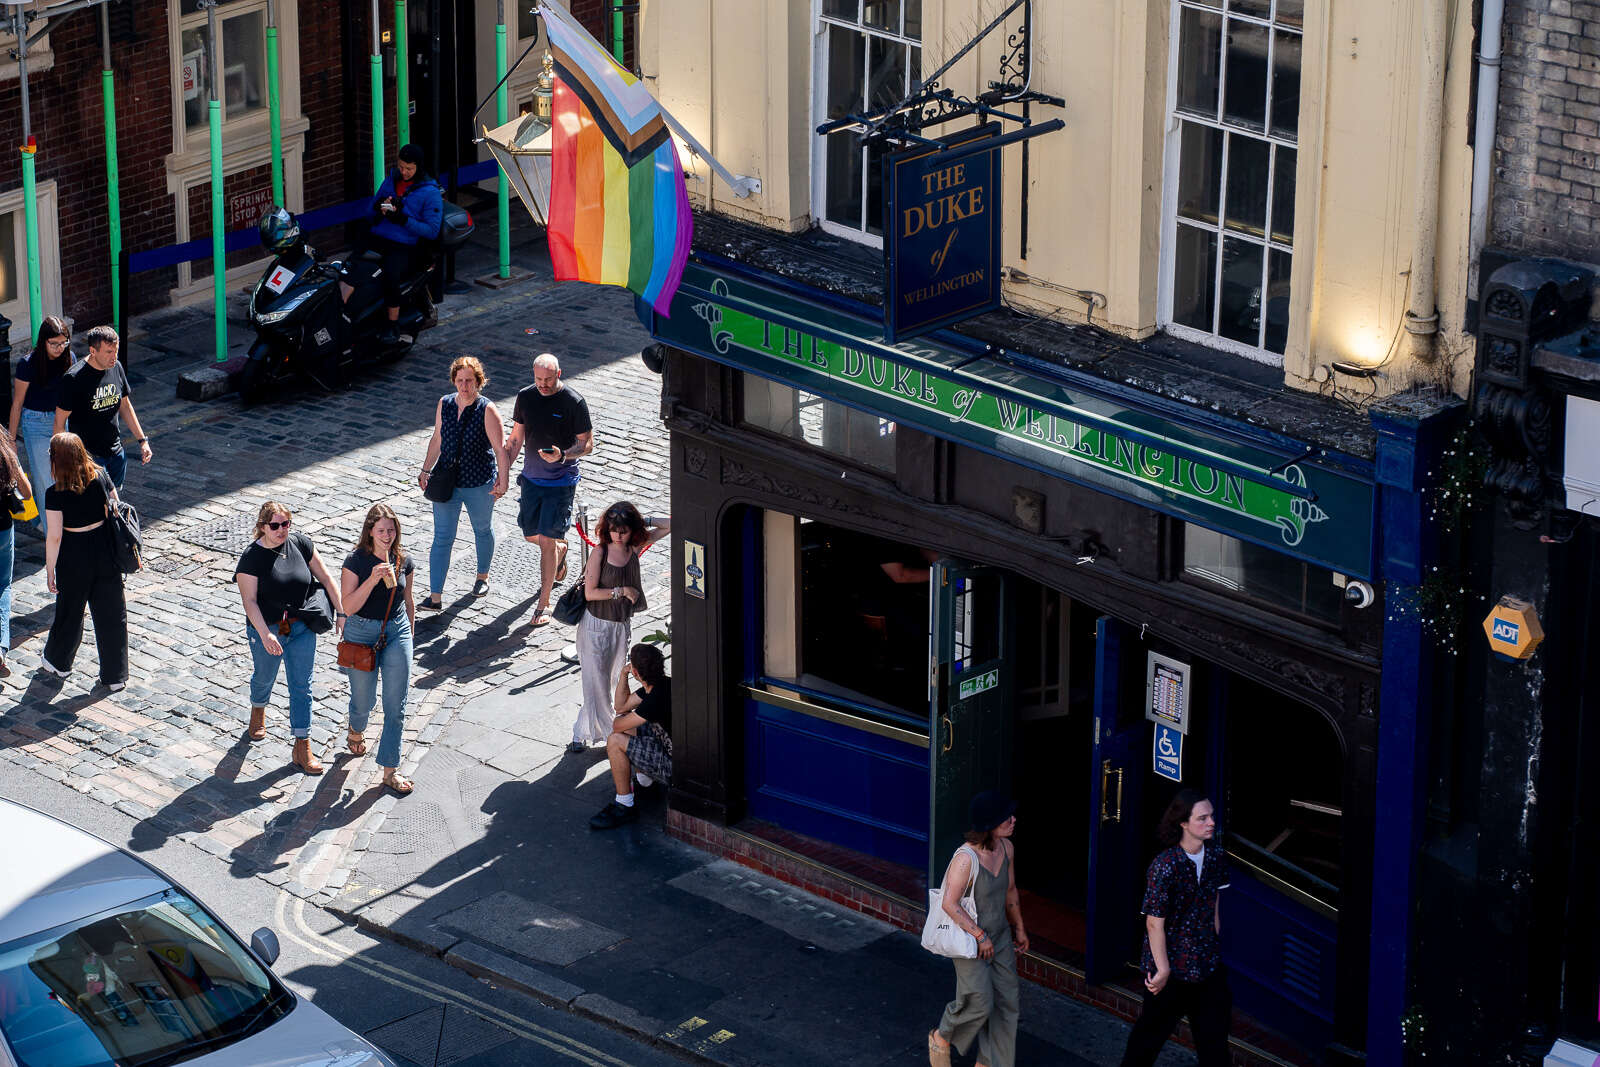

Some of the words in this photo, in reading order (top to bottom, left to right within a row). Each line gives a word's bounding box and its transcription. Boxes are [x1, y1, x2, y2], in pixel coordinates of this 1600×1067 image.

[922, 163, 966, 195] THE
[234, 188, 273, 209] SPRINKL
[234, 206, 257, 222] STOP
[903, 186, 985, 238] DUKE
[930, 227, 959, 279] of
[271, 271, 282, 286] L
[904, 269, 985, 305] WELLINGTON
[93, 383, 117, 400] JACK
[759, 318, 829, 369] THE
[840, 344, 938, 405] DUKE
[950, 388, 982, 423] of
[994, 396, 1247, 512] WELLINGTON
[1493, 623, 1519, 641] ADT
[1158, 761, 1177, 774] Ramp
